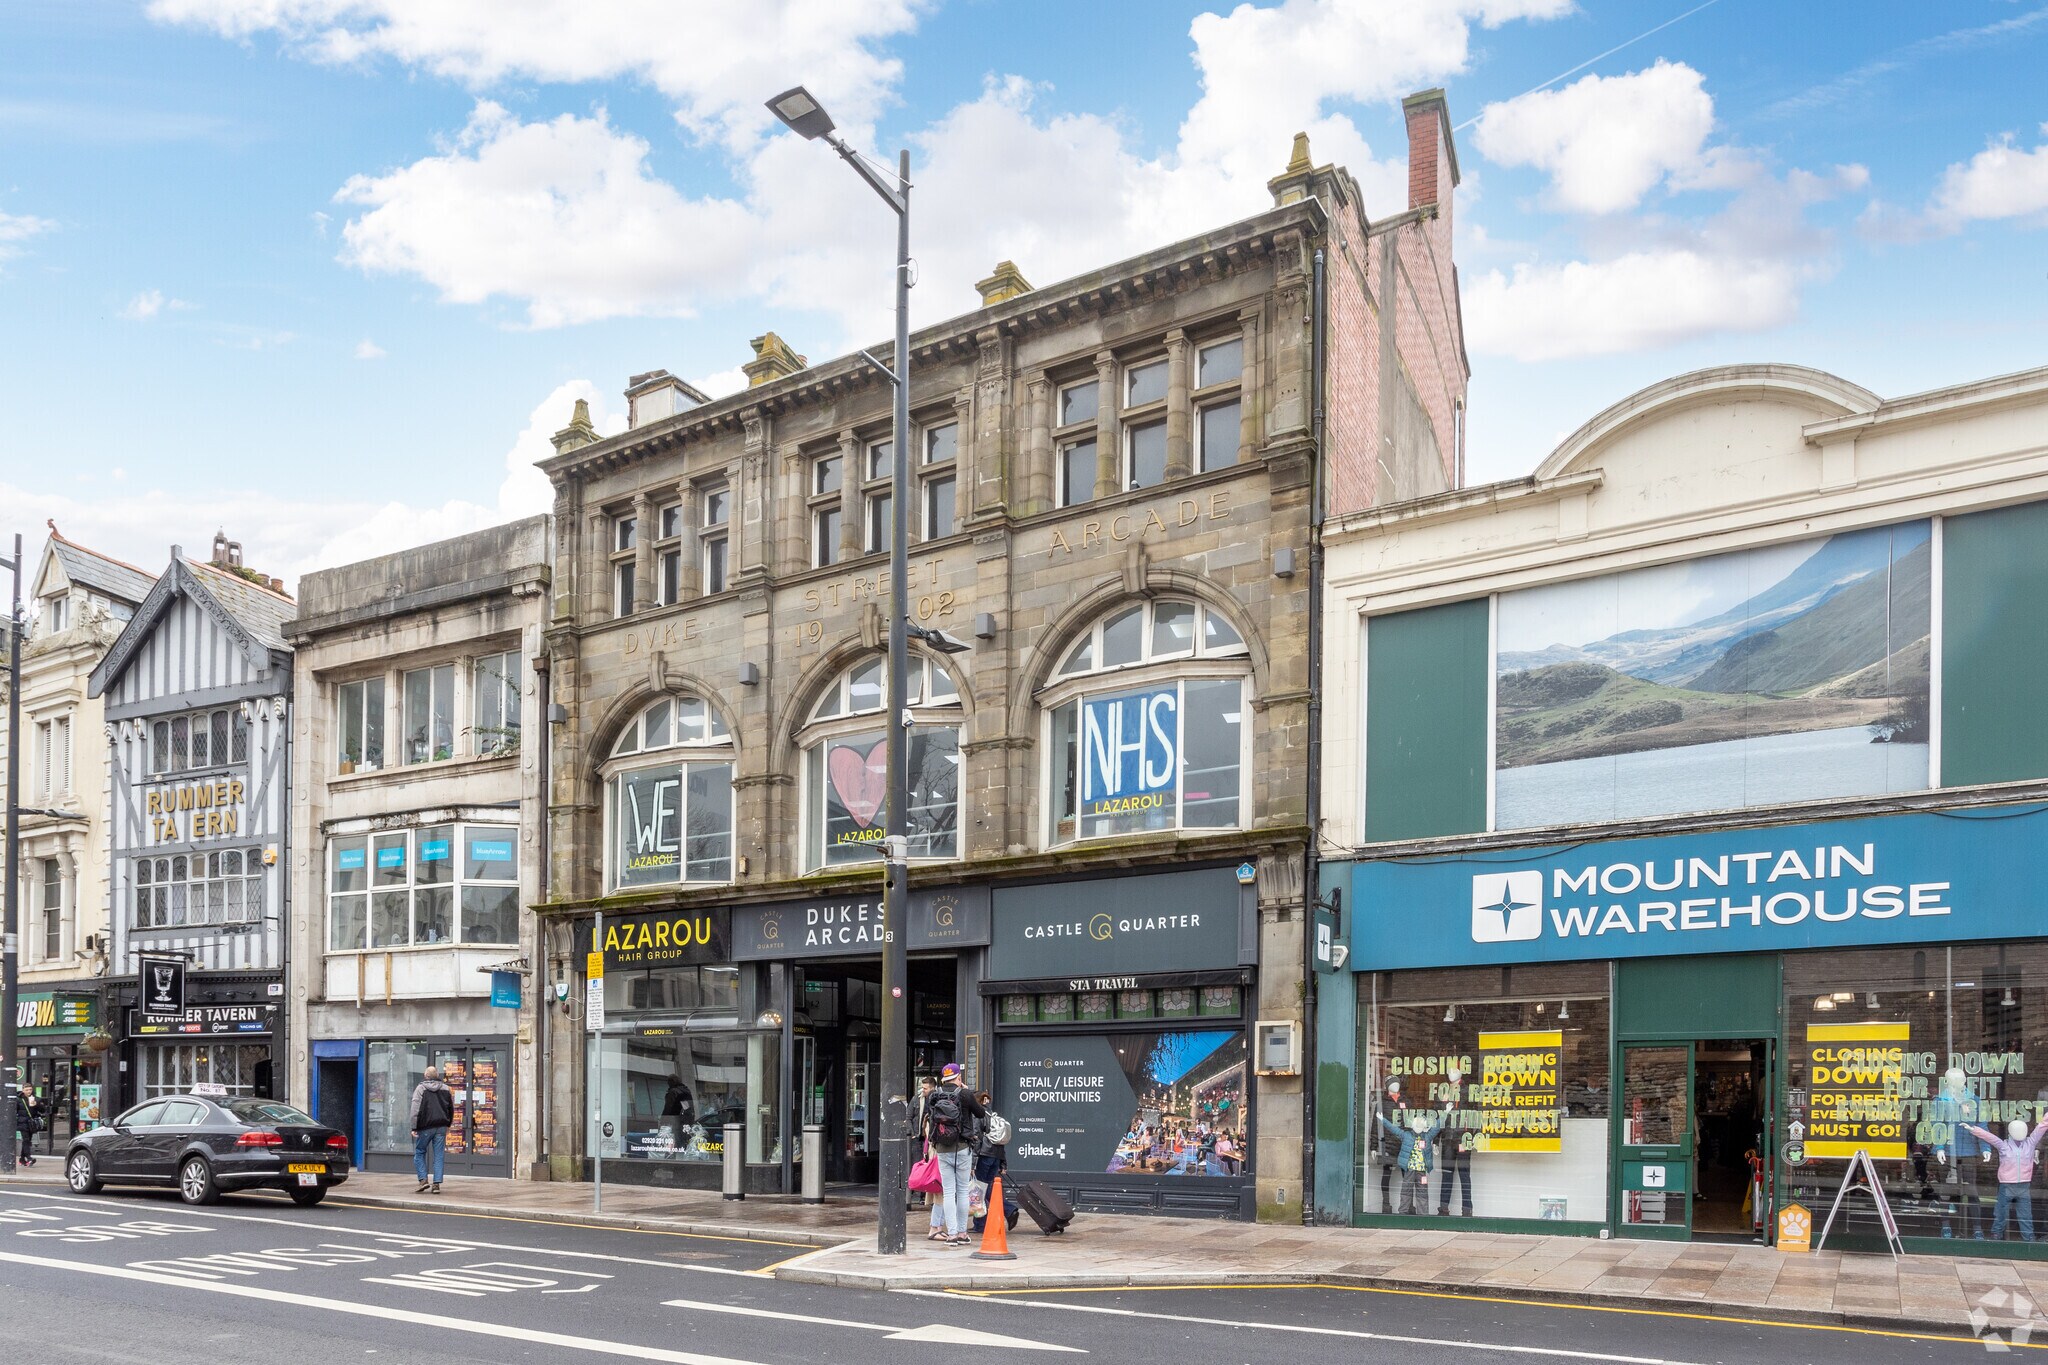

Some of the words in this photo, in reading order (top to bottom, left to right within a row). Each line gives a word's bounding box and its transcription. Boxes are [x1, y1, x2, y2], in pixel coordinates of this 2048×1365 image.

[1048, 490, 1230, 558] ARCADE
[796, 620, 823, 648] 19
[917, 591, 955, 621] 02
[1084, 693, 1176, 801] NHS
[148, 780, 245, 815] RUMMER
[1095, 794, 1163, 814] LAZAROU
[628, 779, 680, 854] WE
[629, 853, 673, 869] LAZAROU
[1553, 842, 1875, 899] MOUNTAIN
[807, 902, 885, 926] DUKES
[1549, 881, 1952, 939] WAREHOUSE
[805, 924, 885, 946] ARCAD
[929, 929, 961, 938] QUARTER
[1024, 923, 1082, 939] CASTLE
[1119, 914, 1201, 933] QUARTER
[756, 942, 785, 950] QUARTER
[886, 932, 893, 942] 3
[618, 951, 643, 962] HAIR
[647, 949, 683, 960] GROUP
[1069, 979, 1091, 991] STA
[1094, 977, 1138, 990] TRAVEL
[16, 1000, 55, 1028] UBWA
[206, 1007, 258, 1022] TAVERN
[1812, 1047, 1902, 1062] CLOSING
[1843, 1051, 1937, 1075] CLOSING
[1953, 1051, 2025, 1074] DOWN
[1390, 1056, 1472, 1076] CLOSING
[1812, 1065, 1902, 1085] DOWN
[1019, 1076, 1052, 1088] RETAIL
[1063, 1076, 1104, 1088] LEISURE
[1483, 1069, 1556, 1087] DOWN
[1883, 1076, 1928, 1099] FOR
[1939, 1076, 2002, 1100] RFIT
[1019, 1091, 1101, 1103] OPPORTUNITIES
[1428, 1082, 1462, 1102] FOR
[1482, 1096, 1512, 1107] FOR
[1515, 1095, 1557, 1107] REFIT
[1811, 1093, 1846, 1106] FOR
[1983, 1100, 2048, 1123] MUST
[1810, 1123, 1862, 1137] MUST
[1866, 1124, 1901, 1138] GO!
[1916, 1121, 1955, 1145] GO!
[697, 1142, 724, 1151] LAZARO
[1018, 1143, 1054, 1159] ejhales
